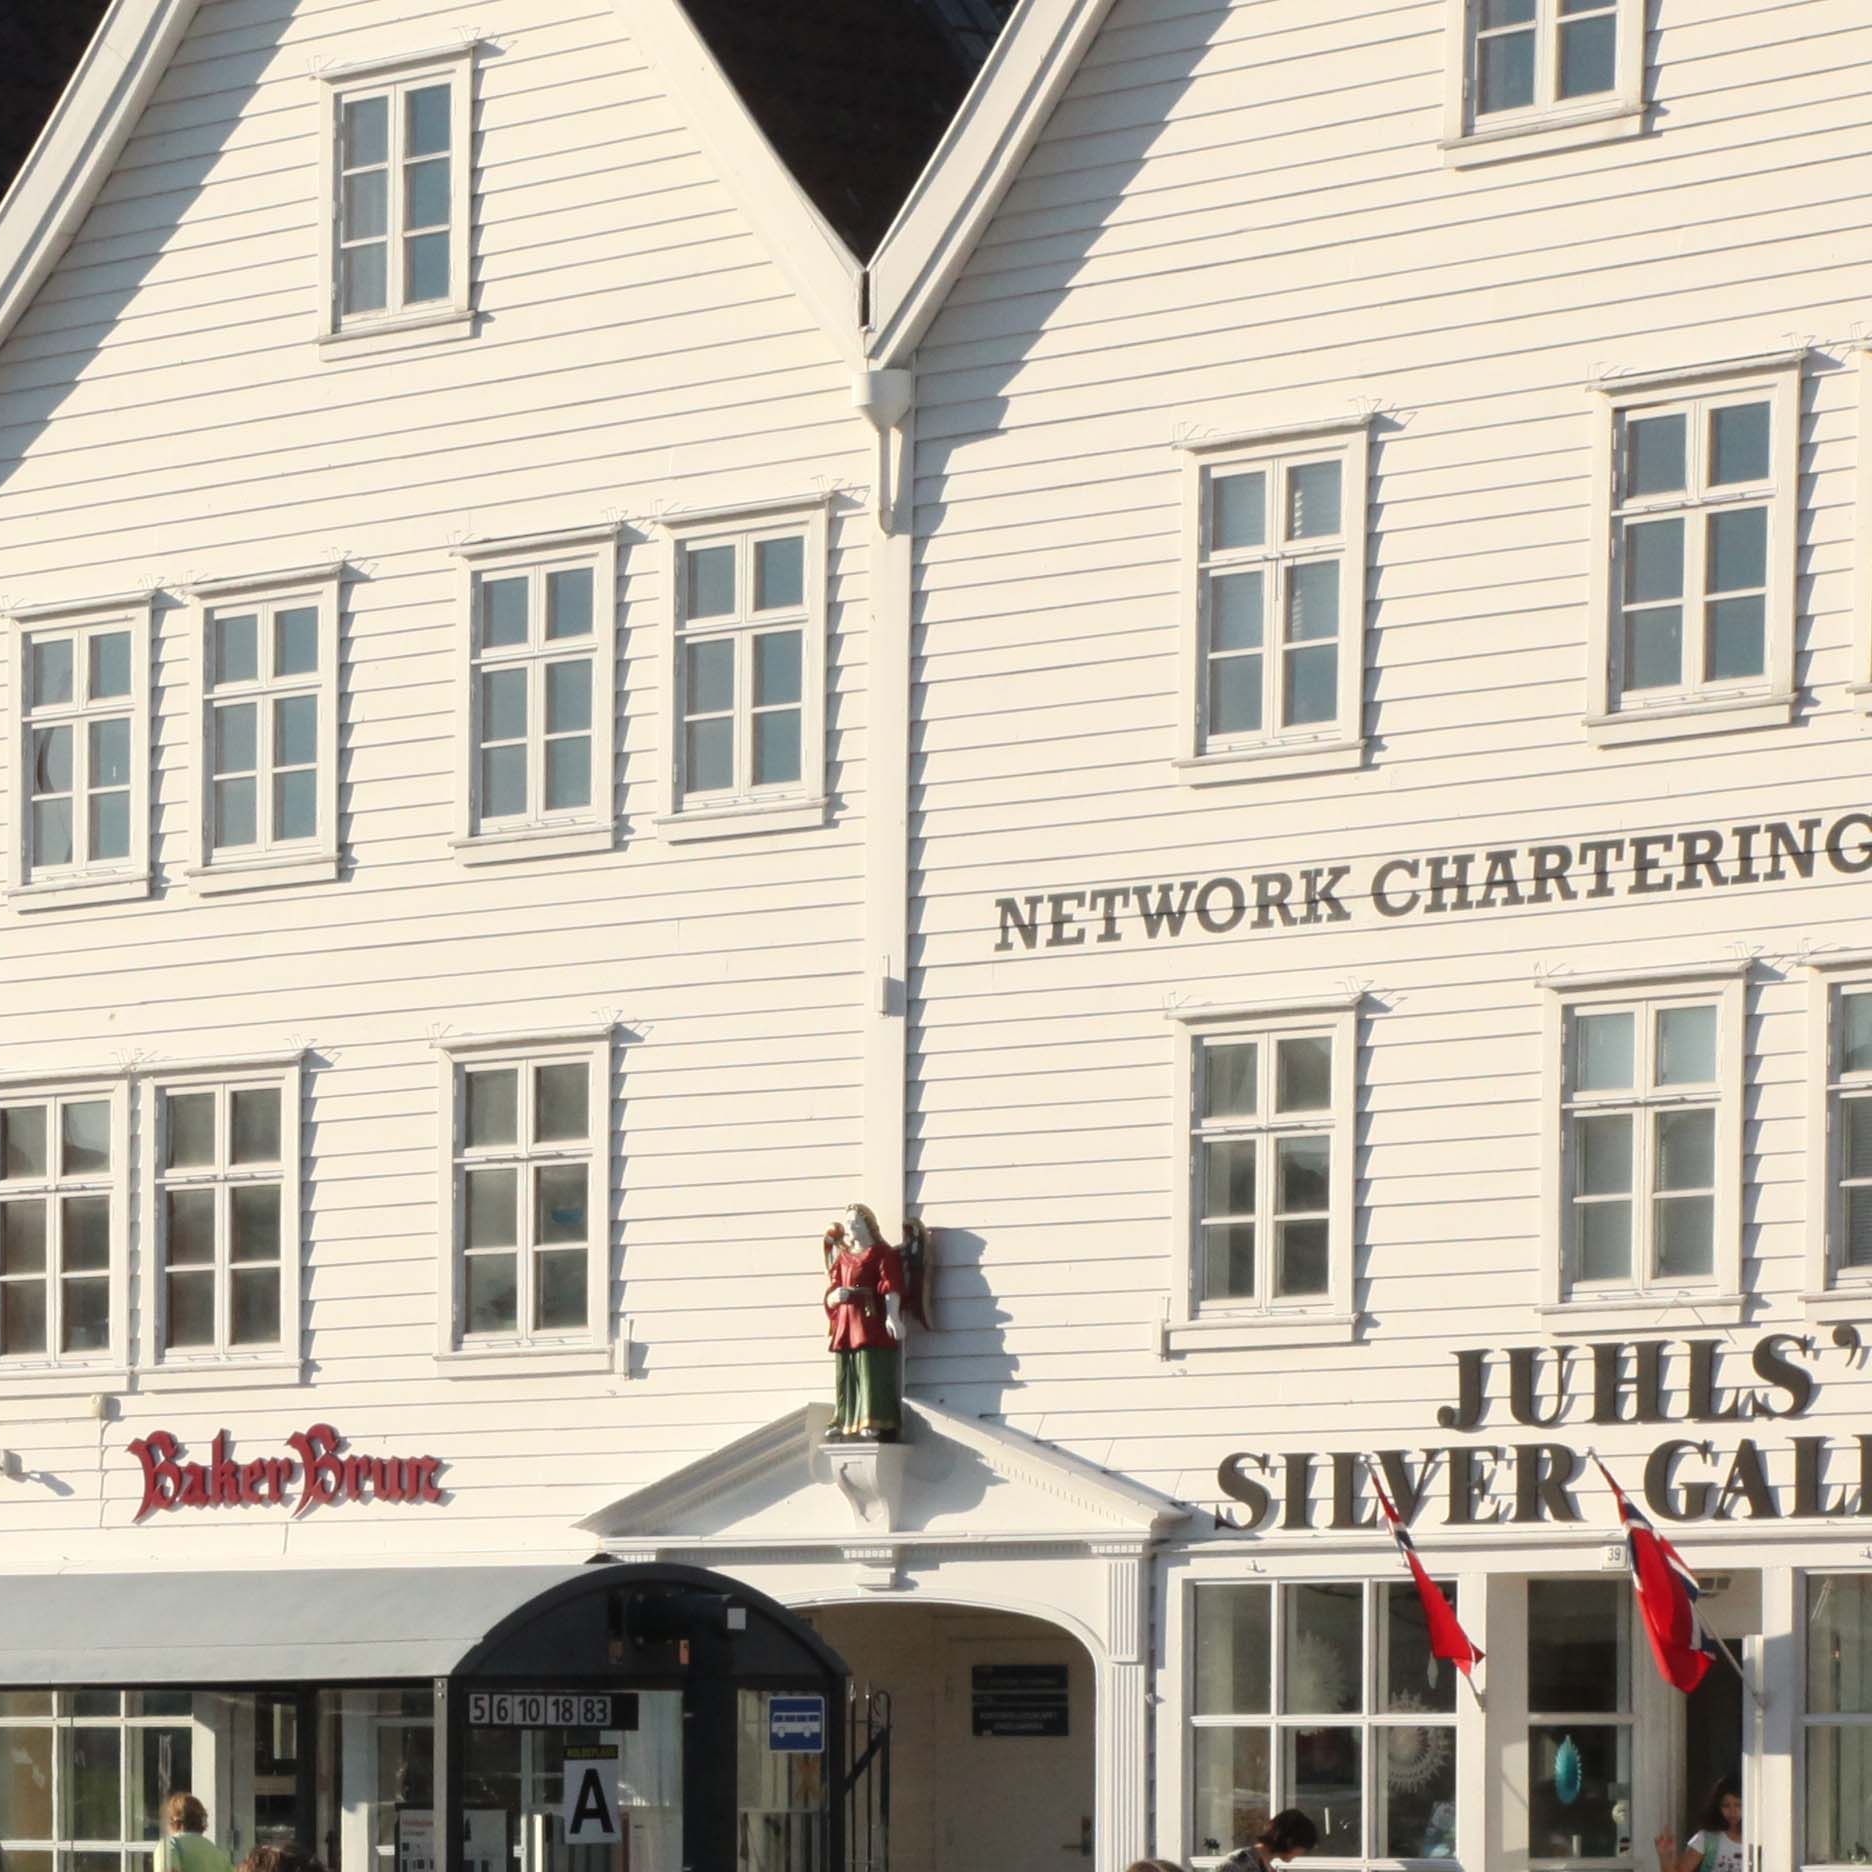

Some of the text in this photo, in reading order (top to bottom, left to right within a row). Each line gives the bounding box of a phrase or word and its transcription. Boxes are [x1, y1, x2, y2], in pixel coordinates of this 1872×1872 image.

[993, 812, 1872, 952] NETWORK CHARTERING
[1214, 1434, 1872, 1531] SILVER GAL
[1607, 1547, 1622, 1561] 39
[473, 1696, 607, 1724] 5 6 10 18 83
[569, 1768, 615, 1835] A
